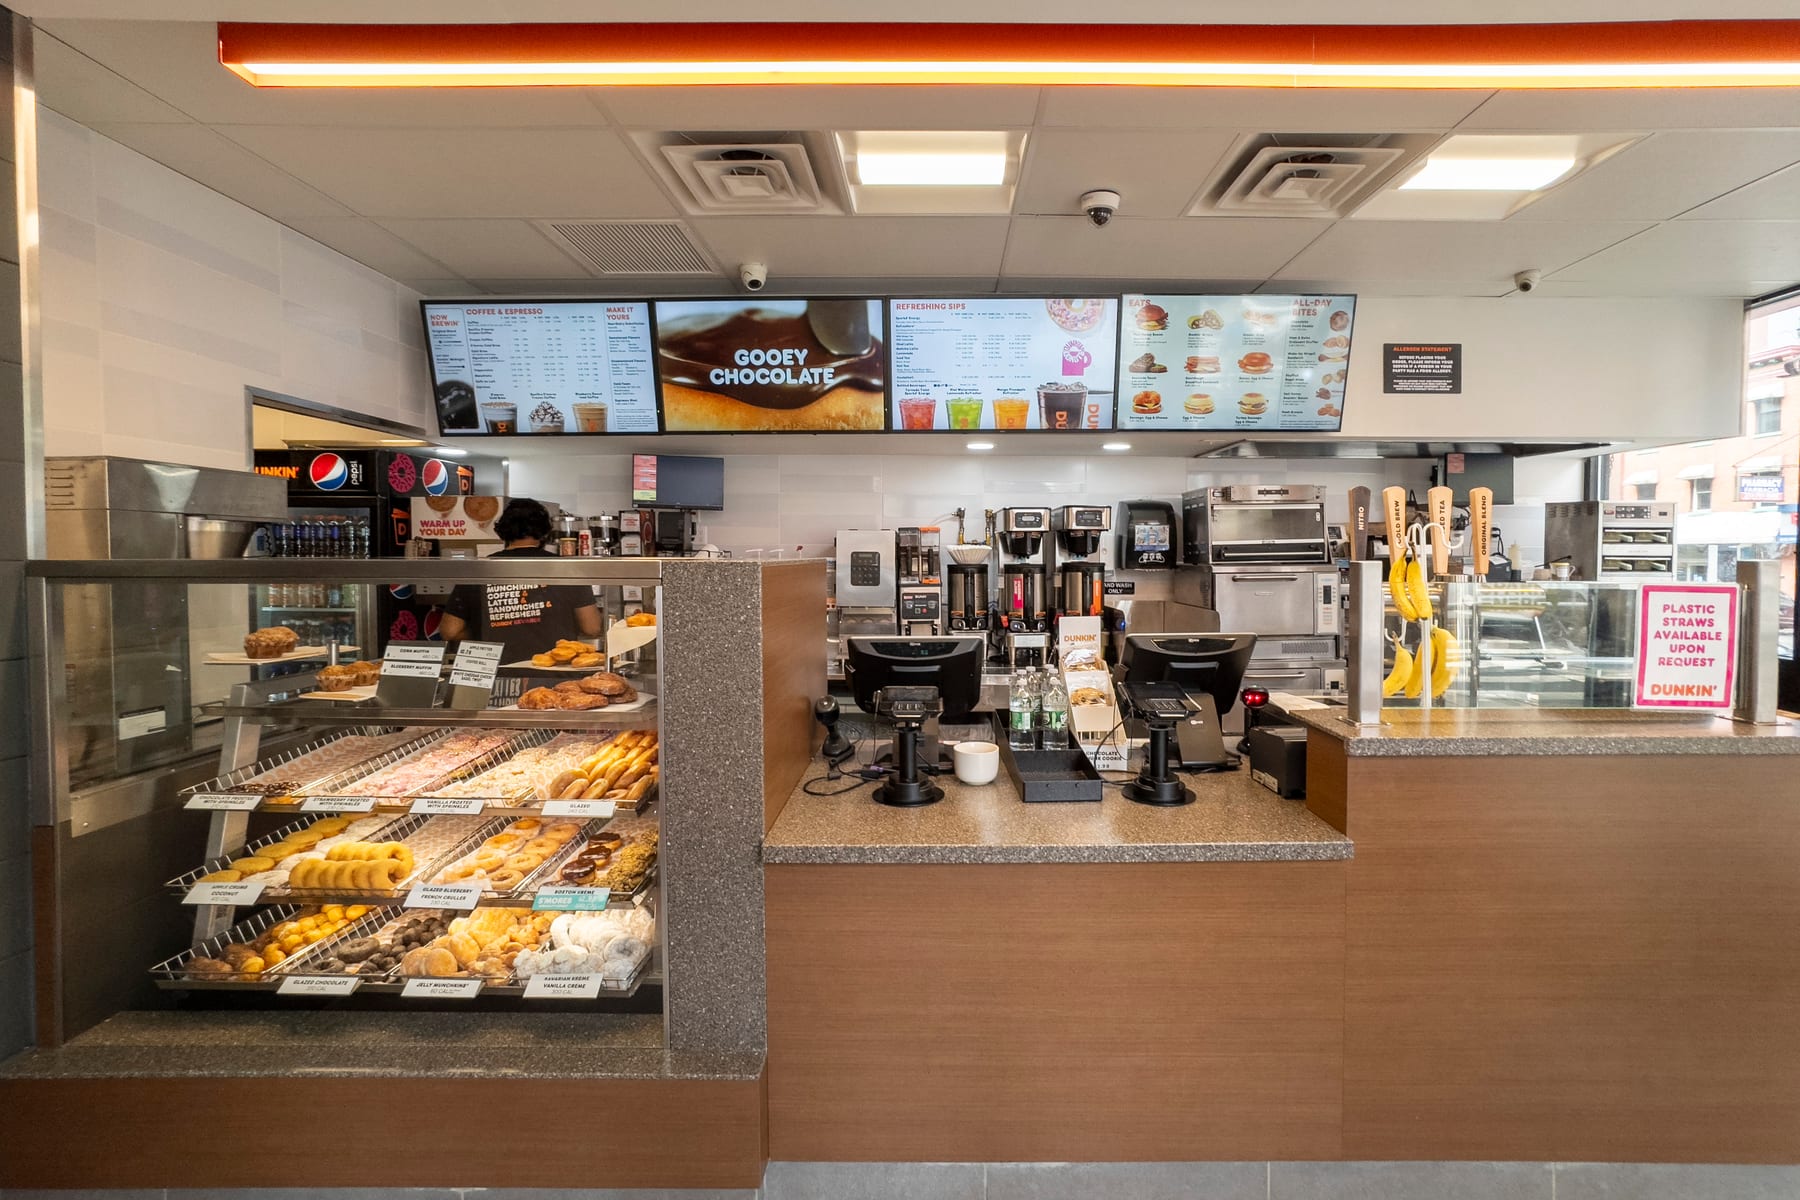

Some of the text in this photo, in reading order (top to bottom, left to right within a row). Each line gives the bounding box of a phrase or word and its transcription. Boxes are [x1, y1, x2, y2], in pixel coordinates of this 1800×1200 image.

[734, 349, 808, 366] GOOEY
[709, 368, 835, 385] CHOCOLATE
[255, 466, 300, 479] UNKIN'
[350, 461, 359, 485] pepsi
[420, 520, 466, 528] WARM UP
[419, 528, 467, 536] YOUR DAY
[487, 584, 539, 593] MUNCHKINS
[488, 591, 520, 600] COFFEE
[488, 598, 518, 606] LATTES
[489, 602, 545, 613] SANDWICHES
[1662, 604, 1715, 614] PLASTIC
[490, 609, 541, 620] REFRESHERS
[1662, 618, 1714, 627] STRAWS
[1064, 634, 1097, 642] DUNKIN'
[1654, 630, 1722, 640] AVAILABLE
[1670, 644, 1705, 654] UPON
[1658, 657, 1715, 667] REQUEST
[1651, 683, 1717, 696] DUNKIN'
